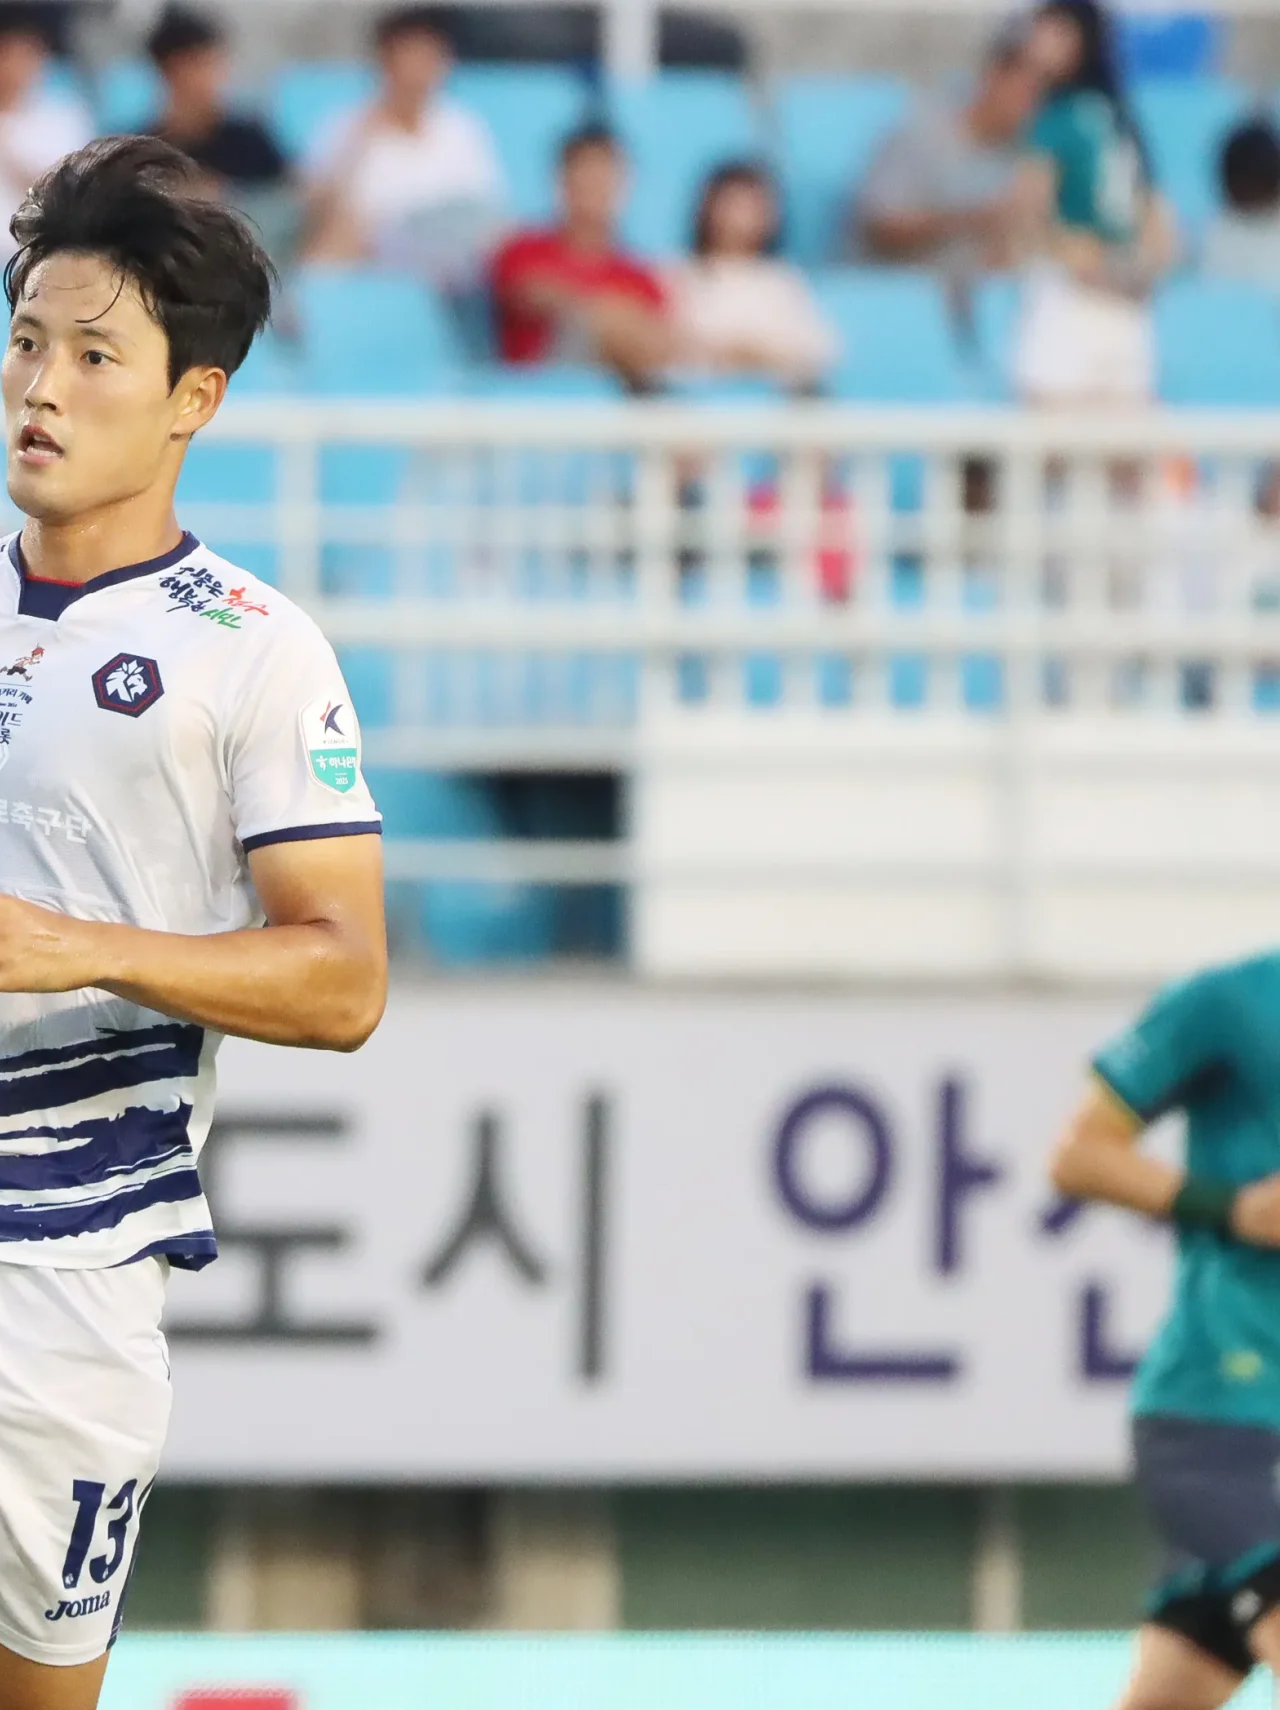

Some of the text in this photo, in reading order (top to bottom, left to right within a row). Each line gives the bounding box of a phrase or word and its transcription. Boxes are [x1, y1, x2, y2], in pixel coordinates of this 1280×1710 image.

[199, 607, 241, 628] 시민
[62, 1479, 137, 1589] 13
[45, 1590, 111, 1621] Joma
